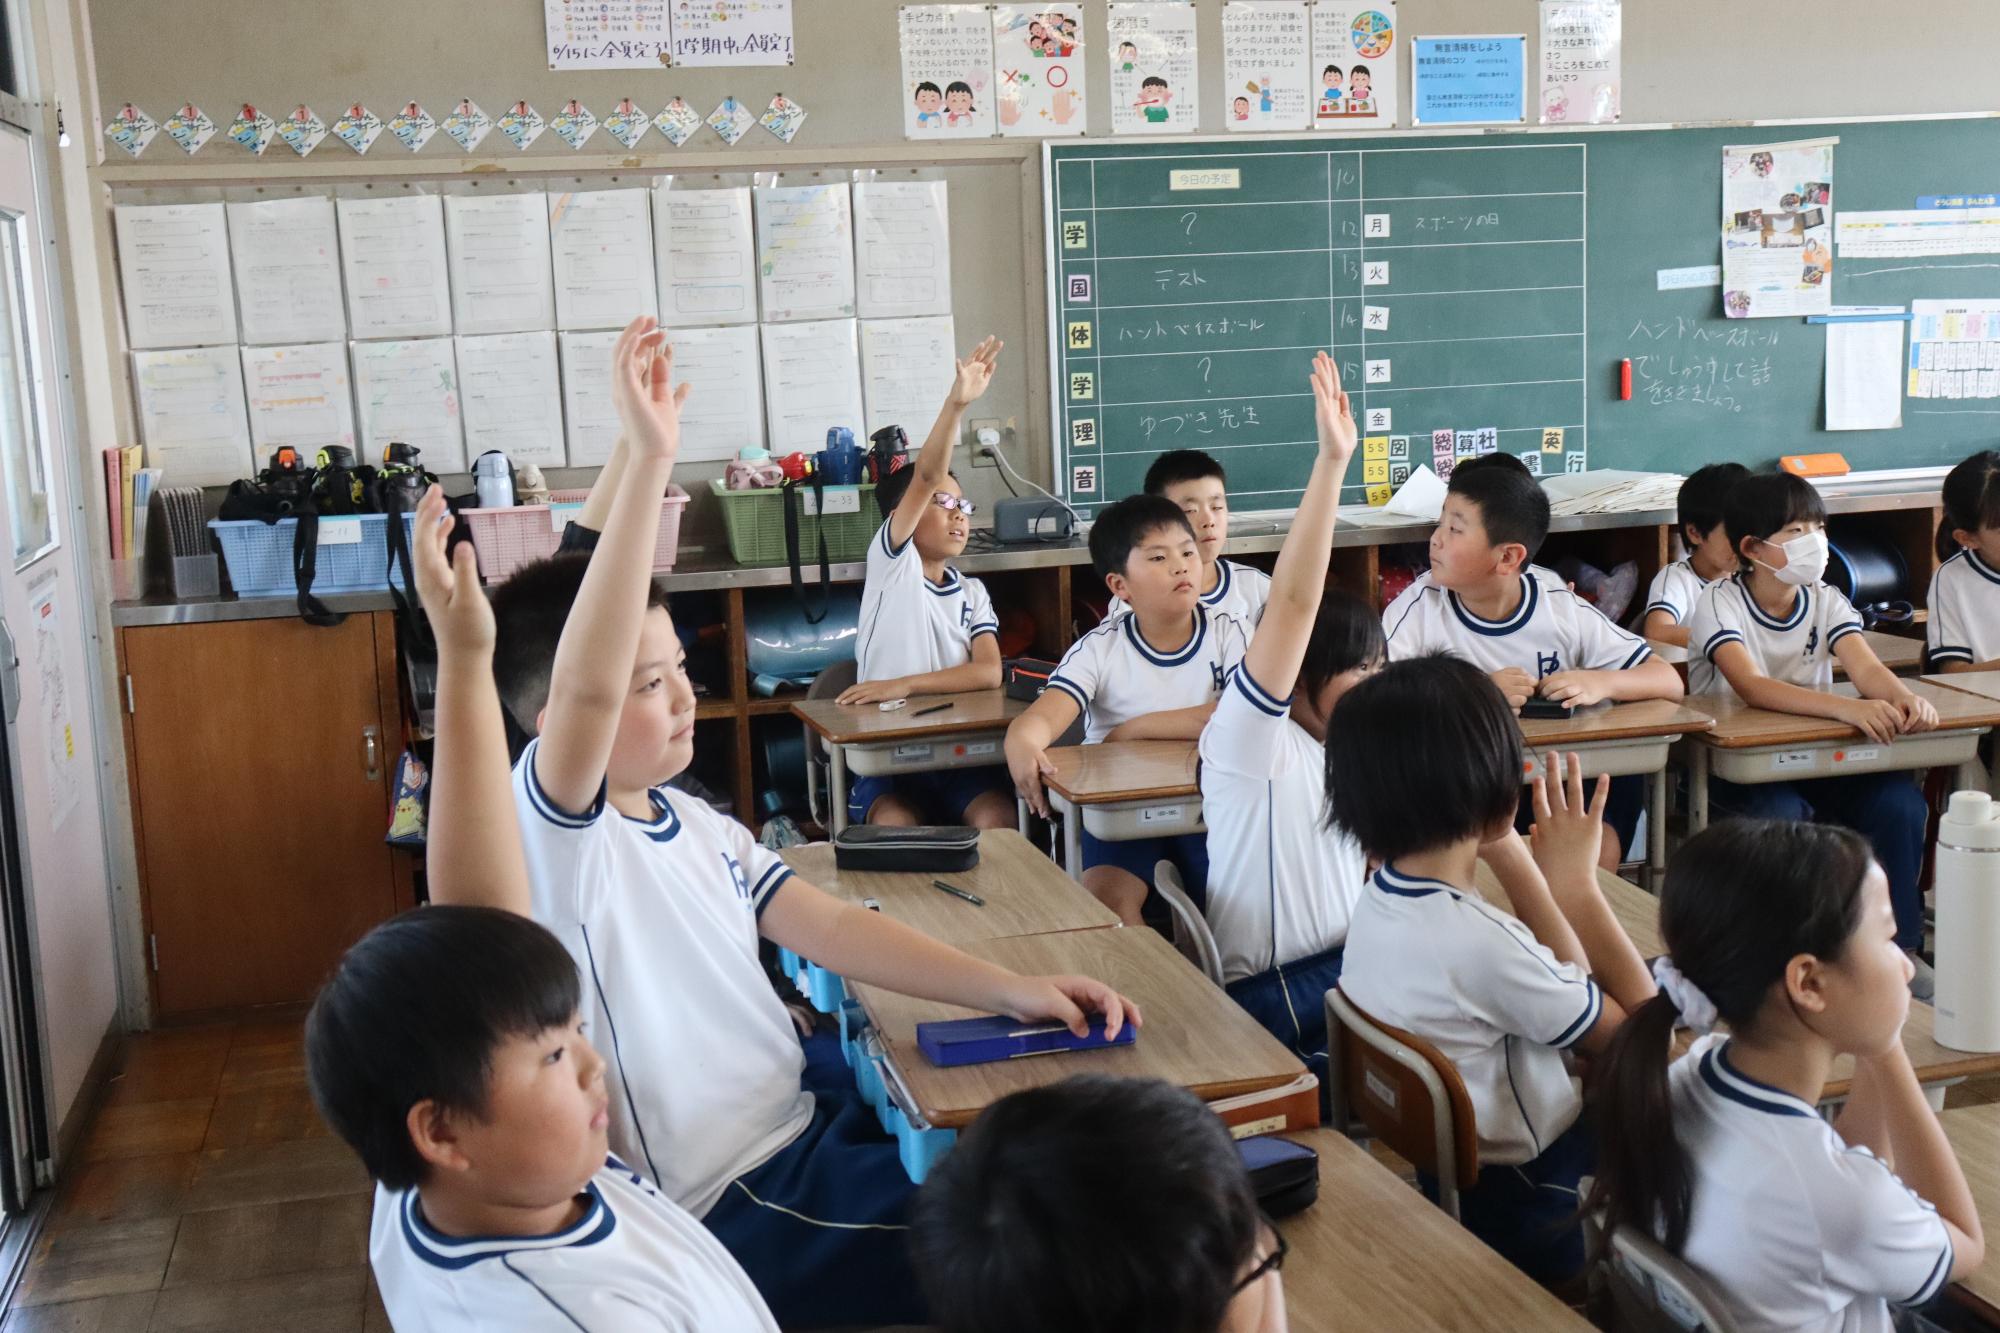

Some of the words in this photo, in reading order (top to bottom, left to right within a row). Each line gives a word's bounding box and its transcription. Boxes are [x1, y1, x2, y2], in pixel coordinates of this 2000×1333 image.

[1180, 174, 1232, 184] 今日の予定
[1342, 220, 1358, 236] 12
[1371, 218, 1382, 232] 月
[1415, 212, 1499, 232] スポーツの日
[1066, 225, 1085, 244] 学
[1343, 253, 1359, 280] 13
[1370, 266, 1383, 279] 火
[1070, 278, 1088, 297] 国
[1370, 310, 1382, 324] 水
[1071, 326, 1089, 345] 体
[1343, 361, 1359, 381] 15
[1371, 363, 1385, 378] 木
[1073, 376, 1091, 395] 学
[1372, 412, 1385, 426] 金
[1074, 422, 1094, 442] 理
[1458, 431, 1475, 452] 算
[1478, 431, 1496, 449] 社
[1544, 431, 1560, 448] 英
[1391, 438, 1407, 456] 図
[1434, 433, 1452, 451] 総
[1523, 455, 1540, 474] 書
[1568, 454, 1584, 473] 行
[1075, 470, 1094, 489] 音
